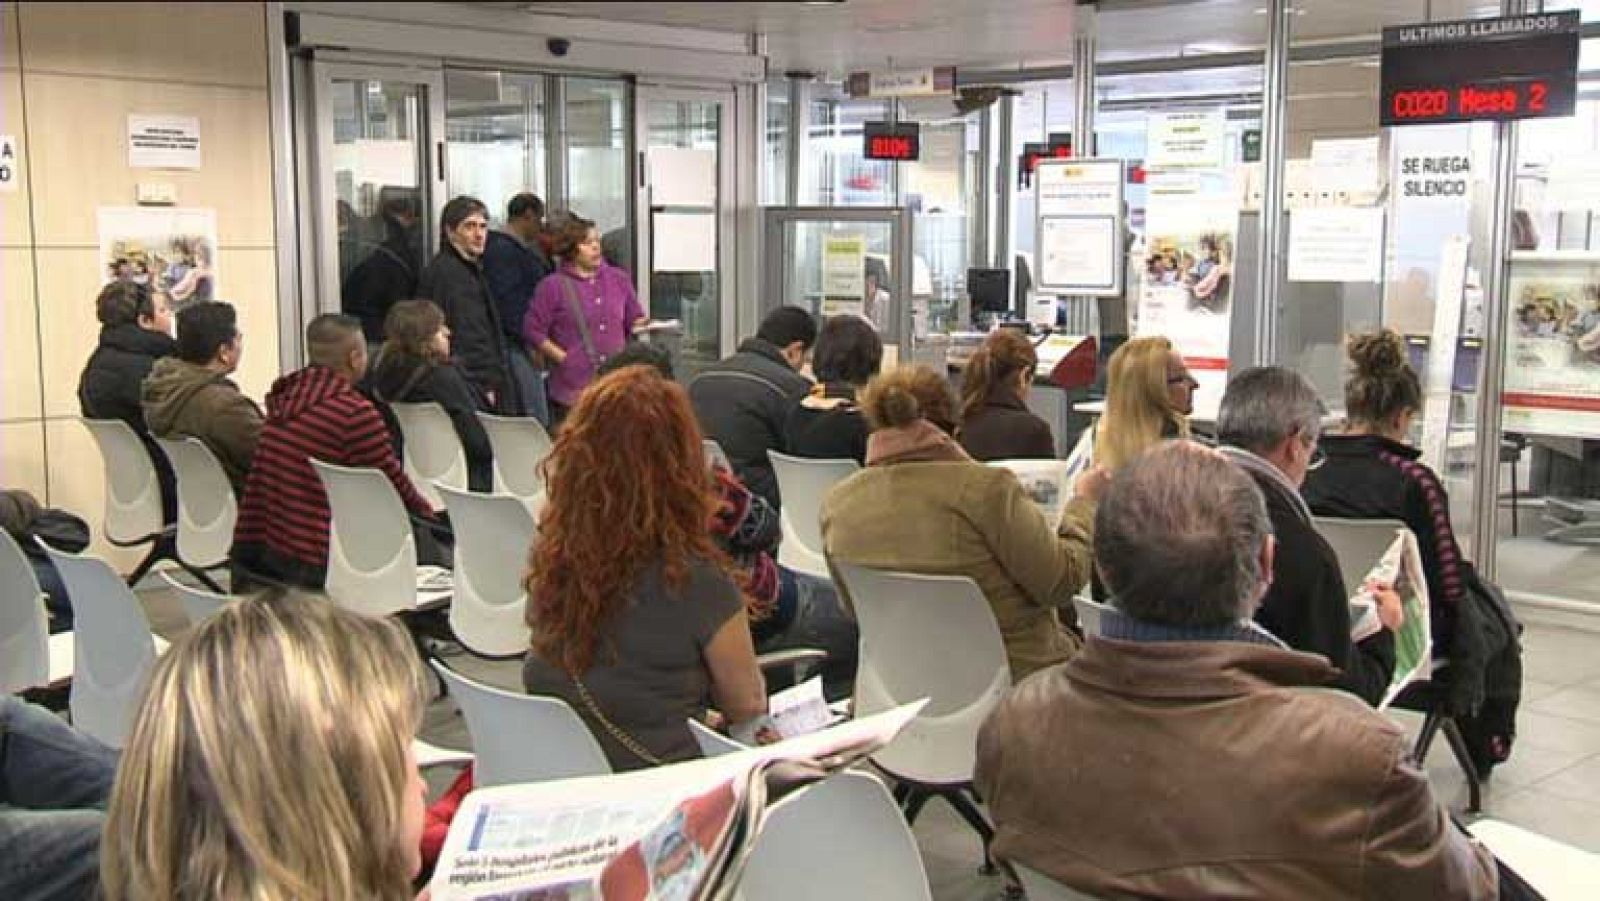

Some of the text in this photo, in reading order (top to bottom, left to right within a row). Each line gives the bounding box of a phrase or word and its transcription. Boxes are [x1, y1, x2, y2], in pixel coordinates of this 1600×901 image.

[1400, 16, 1559, 42] ULTIMOS LLAMADOS
[1459, 87, 1517, 115] Mesa
[1529, 82, 1547, 111] 2
[1402, 156, 1471, 174] SE RUEGA
[1404, 180, 1466, 197] SILENCIO
